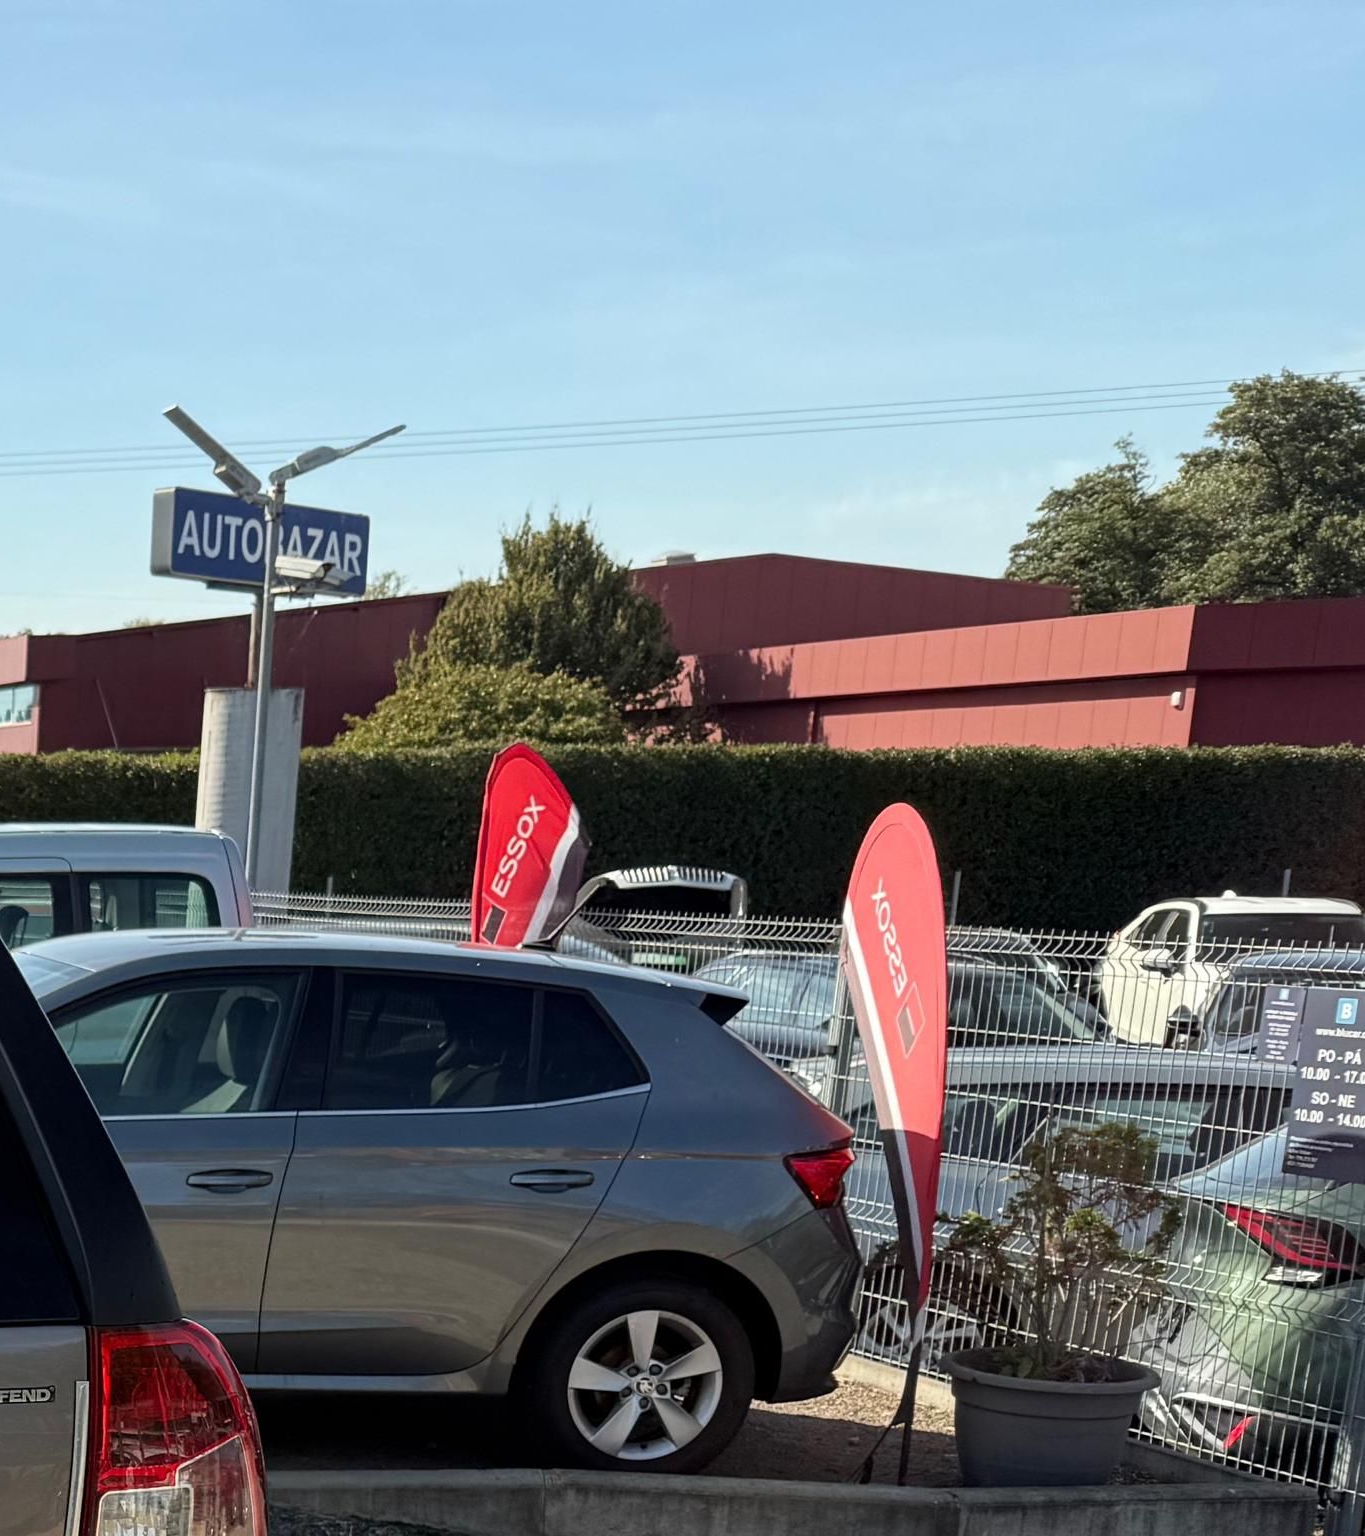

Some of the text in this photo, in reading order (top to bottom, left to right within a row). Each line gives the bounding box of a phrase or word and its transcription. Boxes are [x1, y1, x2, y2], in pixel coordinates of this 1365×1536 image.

[491, 794, 546, 898] ESSOX
[1300, 1066, 1330, 1081] 10.00
[1294, 1108, 1324, 1123] 10.00
